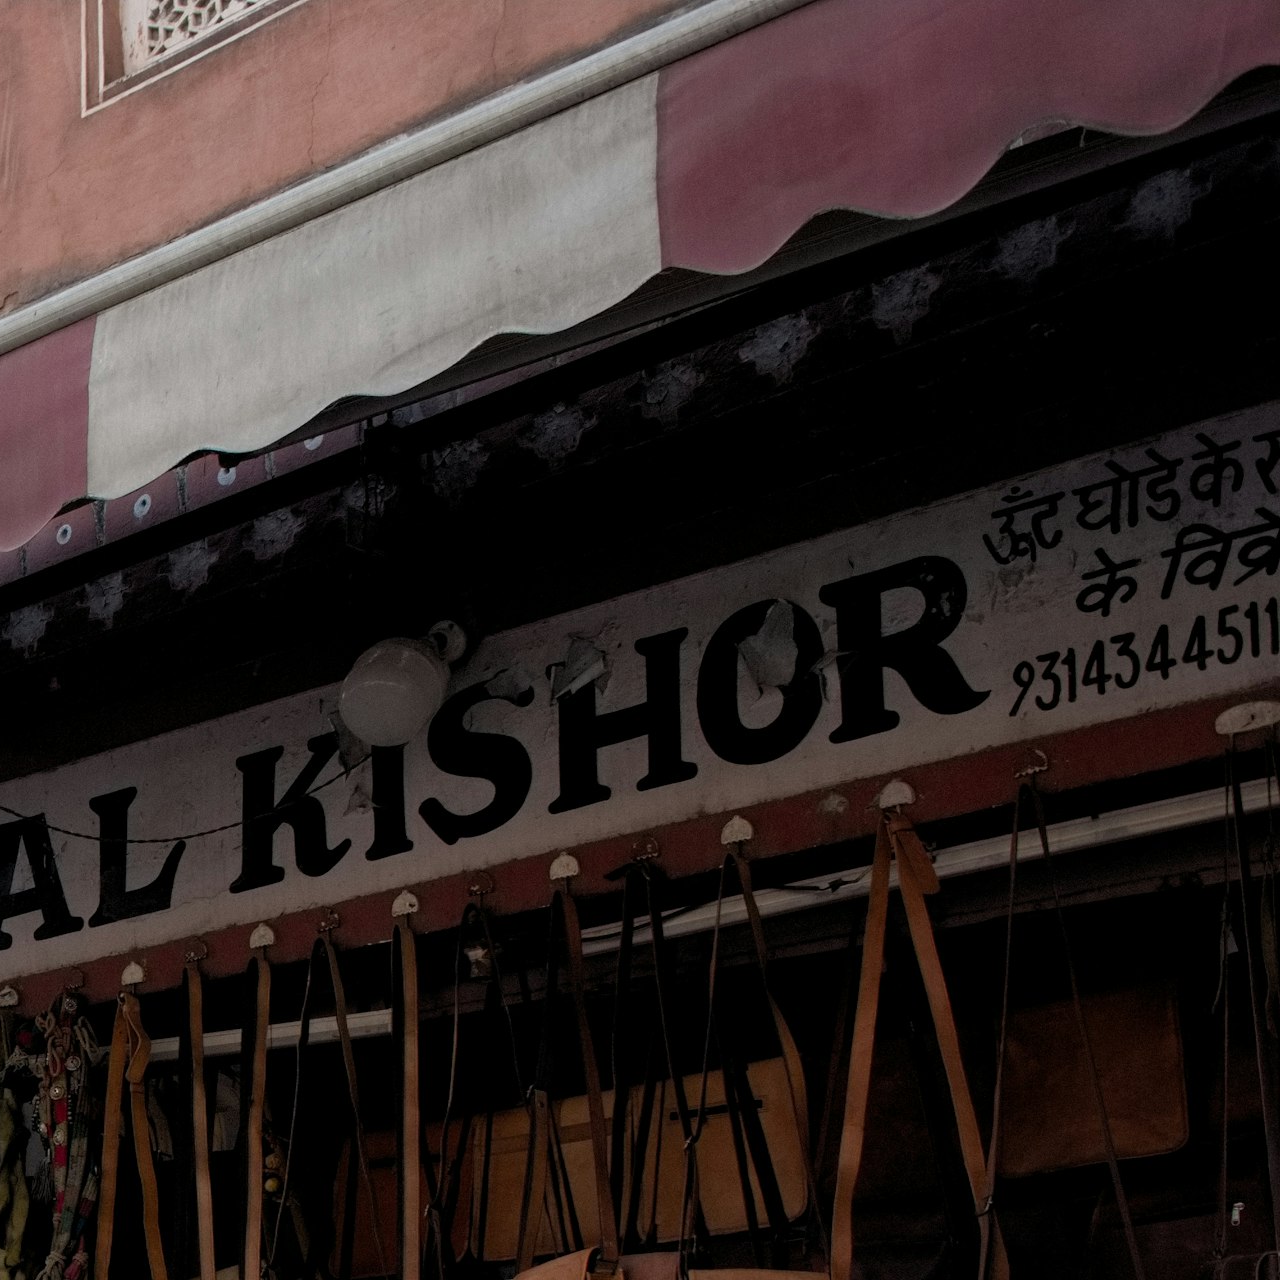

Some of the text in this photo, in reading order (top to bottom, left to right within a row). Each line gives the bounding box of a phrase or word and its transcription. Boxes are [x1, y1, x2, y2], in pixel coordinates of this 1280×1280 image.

[1190, 433, 1245, 507] के
[1076, 548, 1141, 617] के
[1009, 597, 1280, 716] 9314344511
[230, 554, 992, 893] KISHOR
